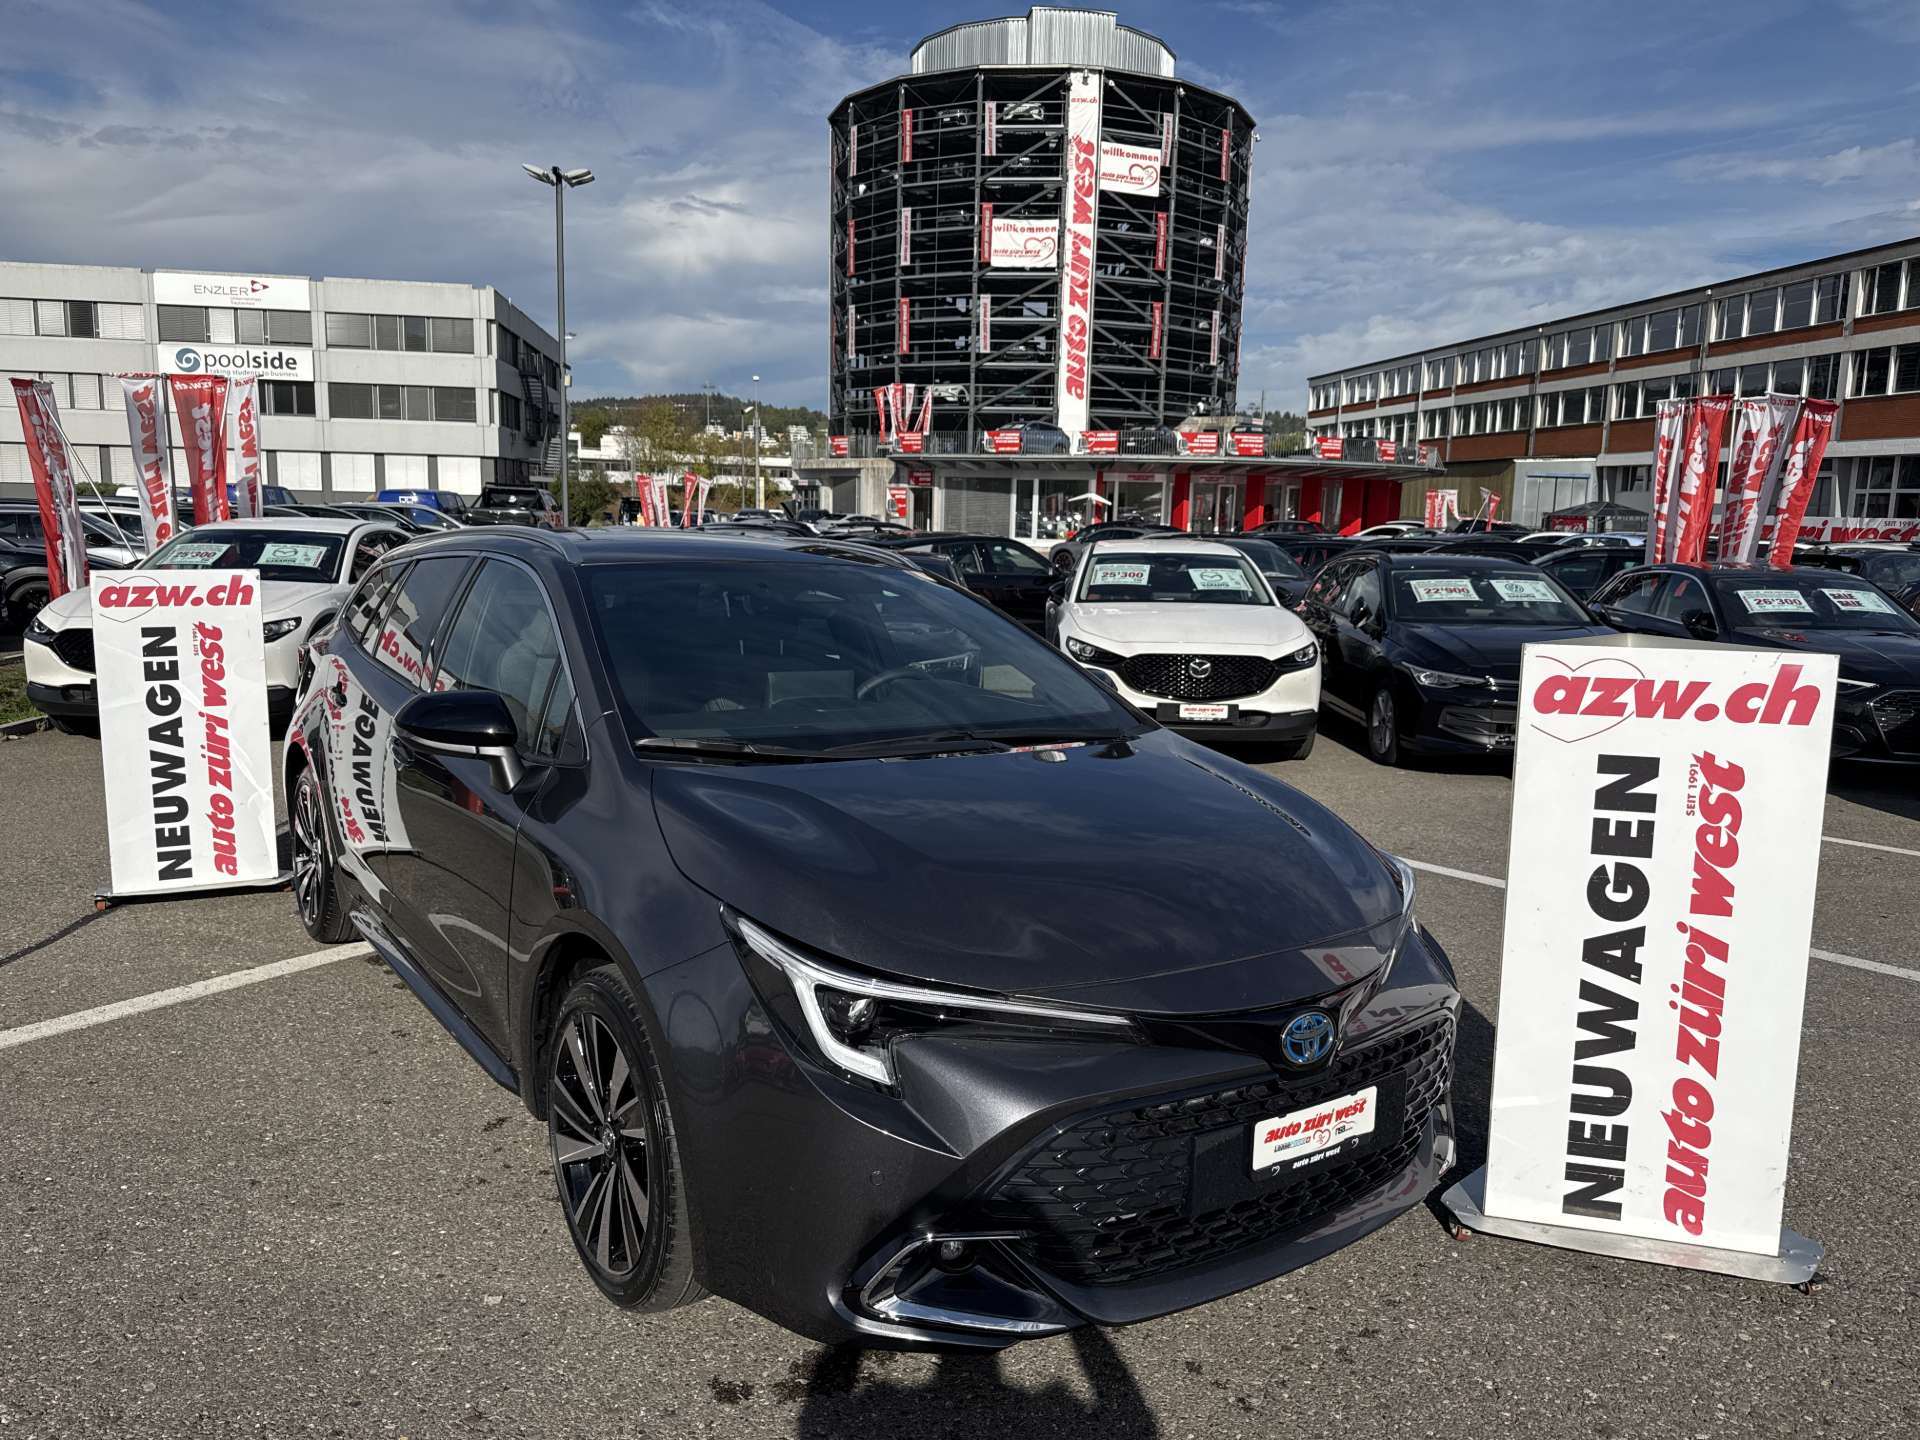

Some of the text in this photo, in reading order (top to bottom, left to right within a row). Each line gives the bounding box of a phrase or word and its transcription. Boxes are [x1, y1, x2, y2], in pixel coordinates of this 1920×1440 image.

[1102, 146, 1159, 162] willkommen
[993, 223, 1057, 233] willkommen
[1064, 134, 1095, 400] auto züri west
[193, 284, 249, 296] ENZLER
[204, 350, 297, 373] poolside
[99, 575, 254, 608] azw.ch
[1101, 571, 1144, 579] 25'300
[1753, 598, 1802, 606] 26'300
[1533, 664, 1821, 726] azw.ch
[141, 626, 193, 881] NEUWAGEN
[193, 621, 238, 877] auto züri west
[1686, 763, 1699, 817] SEIT 1991
[1562, 754, 1661, 1221] NEUWAGEN
[1660, 750, 1746, 1237] auto züri west
[1264, 1121, 1301, 1144] auto
[1302, 1108, 1334, 1133] züri
[1335, 1098, 1367, 1121] west
[1292, 1158, 1309, 1169] auto
[1325, 1146, 1341, 1159] west
